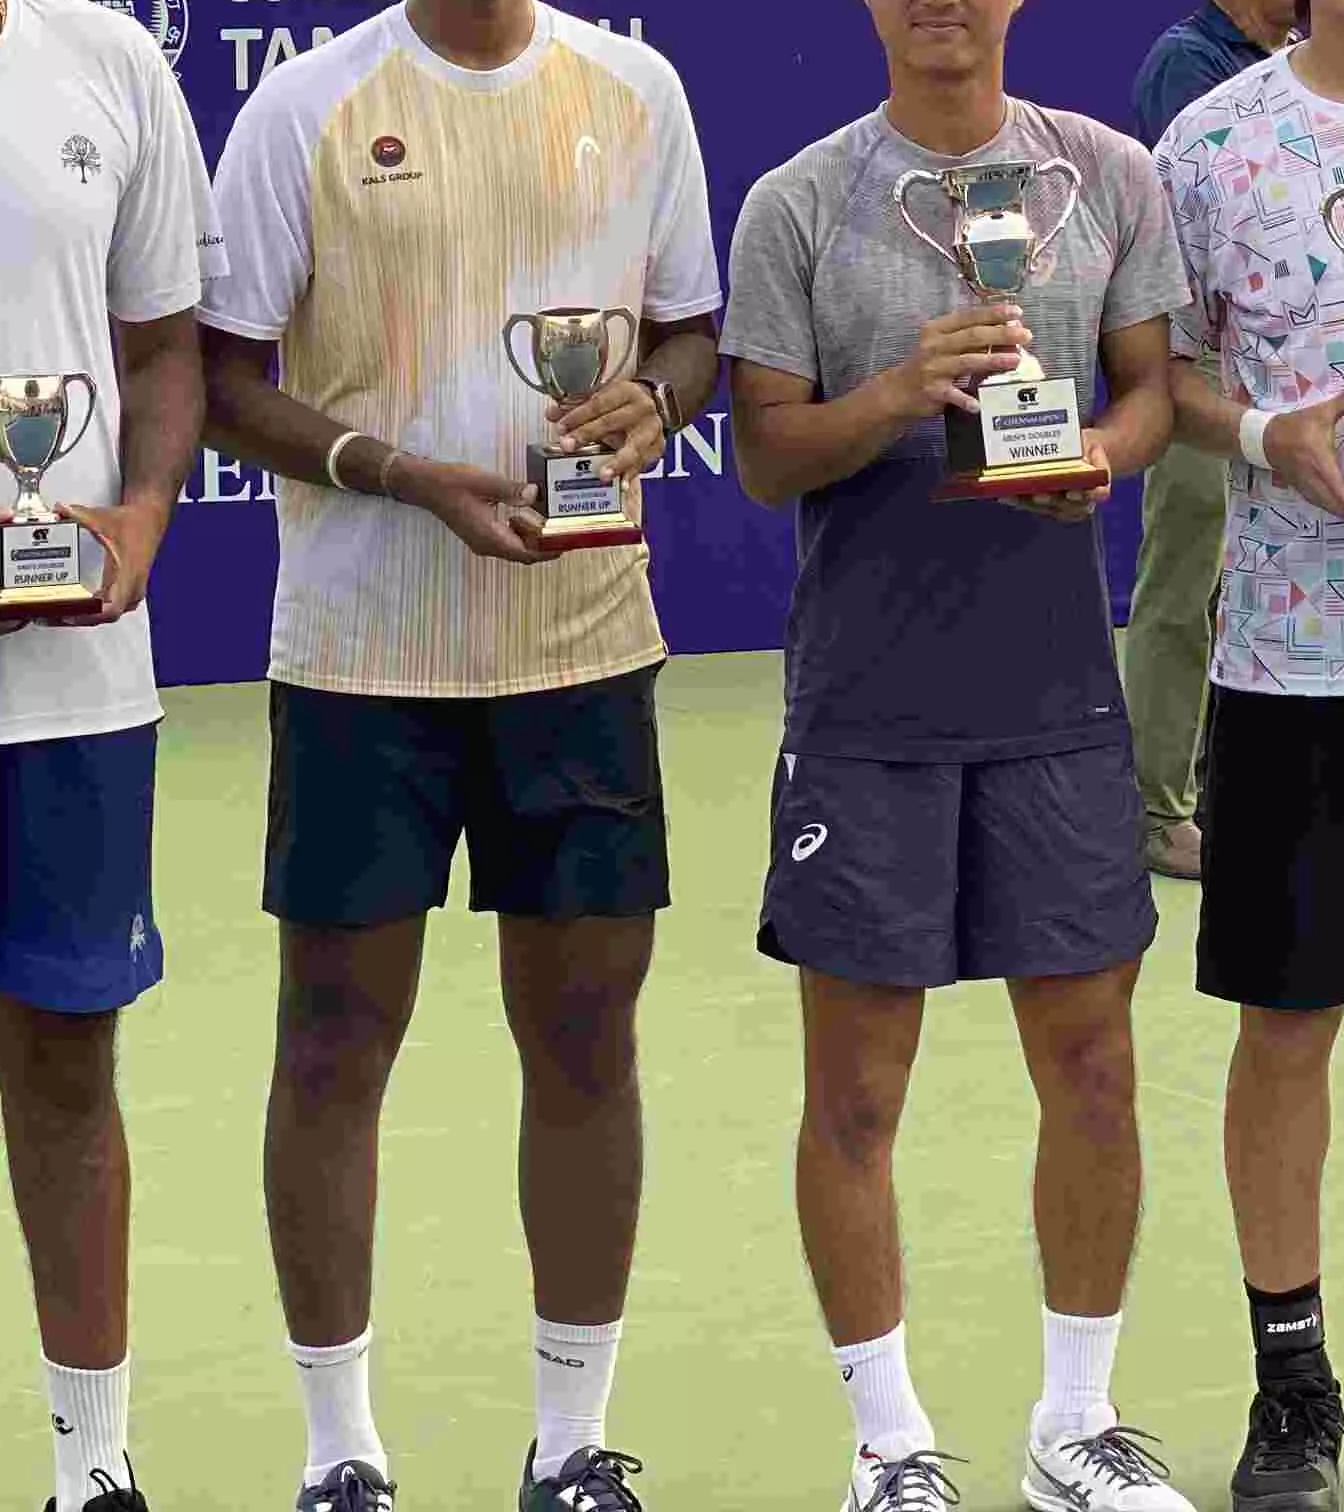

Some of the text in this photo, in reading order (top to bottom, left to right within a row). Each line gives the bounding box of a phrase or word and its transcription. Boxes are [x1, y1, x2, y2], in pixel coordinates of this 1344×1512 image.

[389, 171, 423, 182] GROUP
[1009, 443, 1058, 458] WINNER
[559, 501, 596, 513] RUNNER
[15, 571, 69, 584] RUNNER UP
